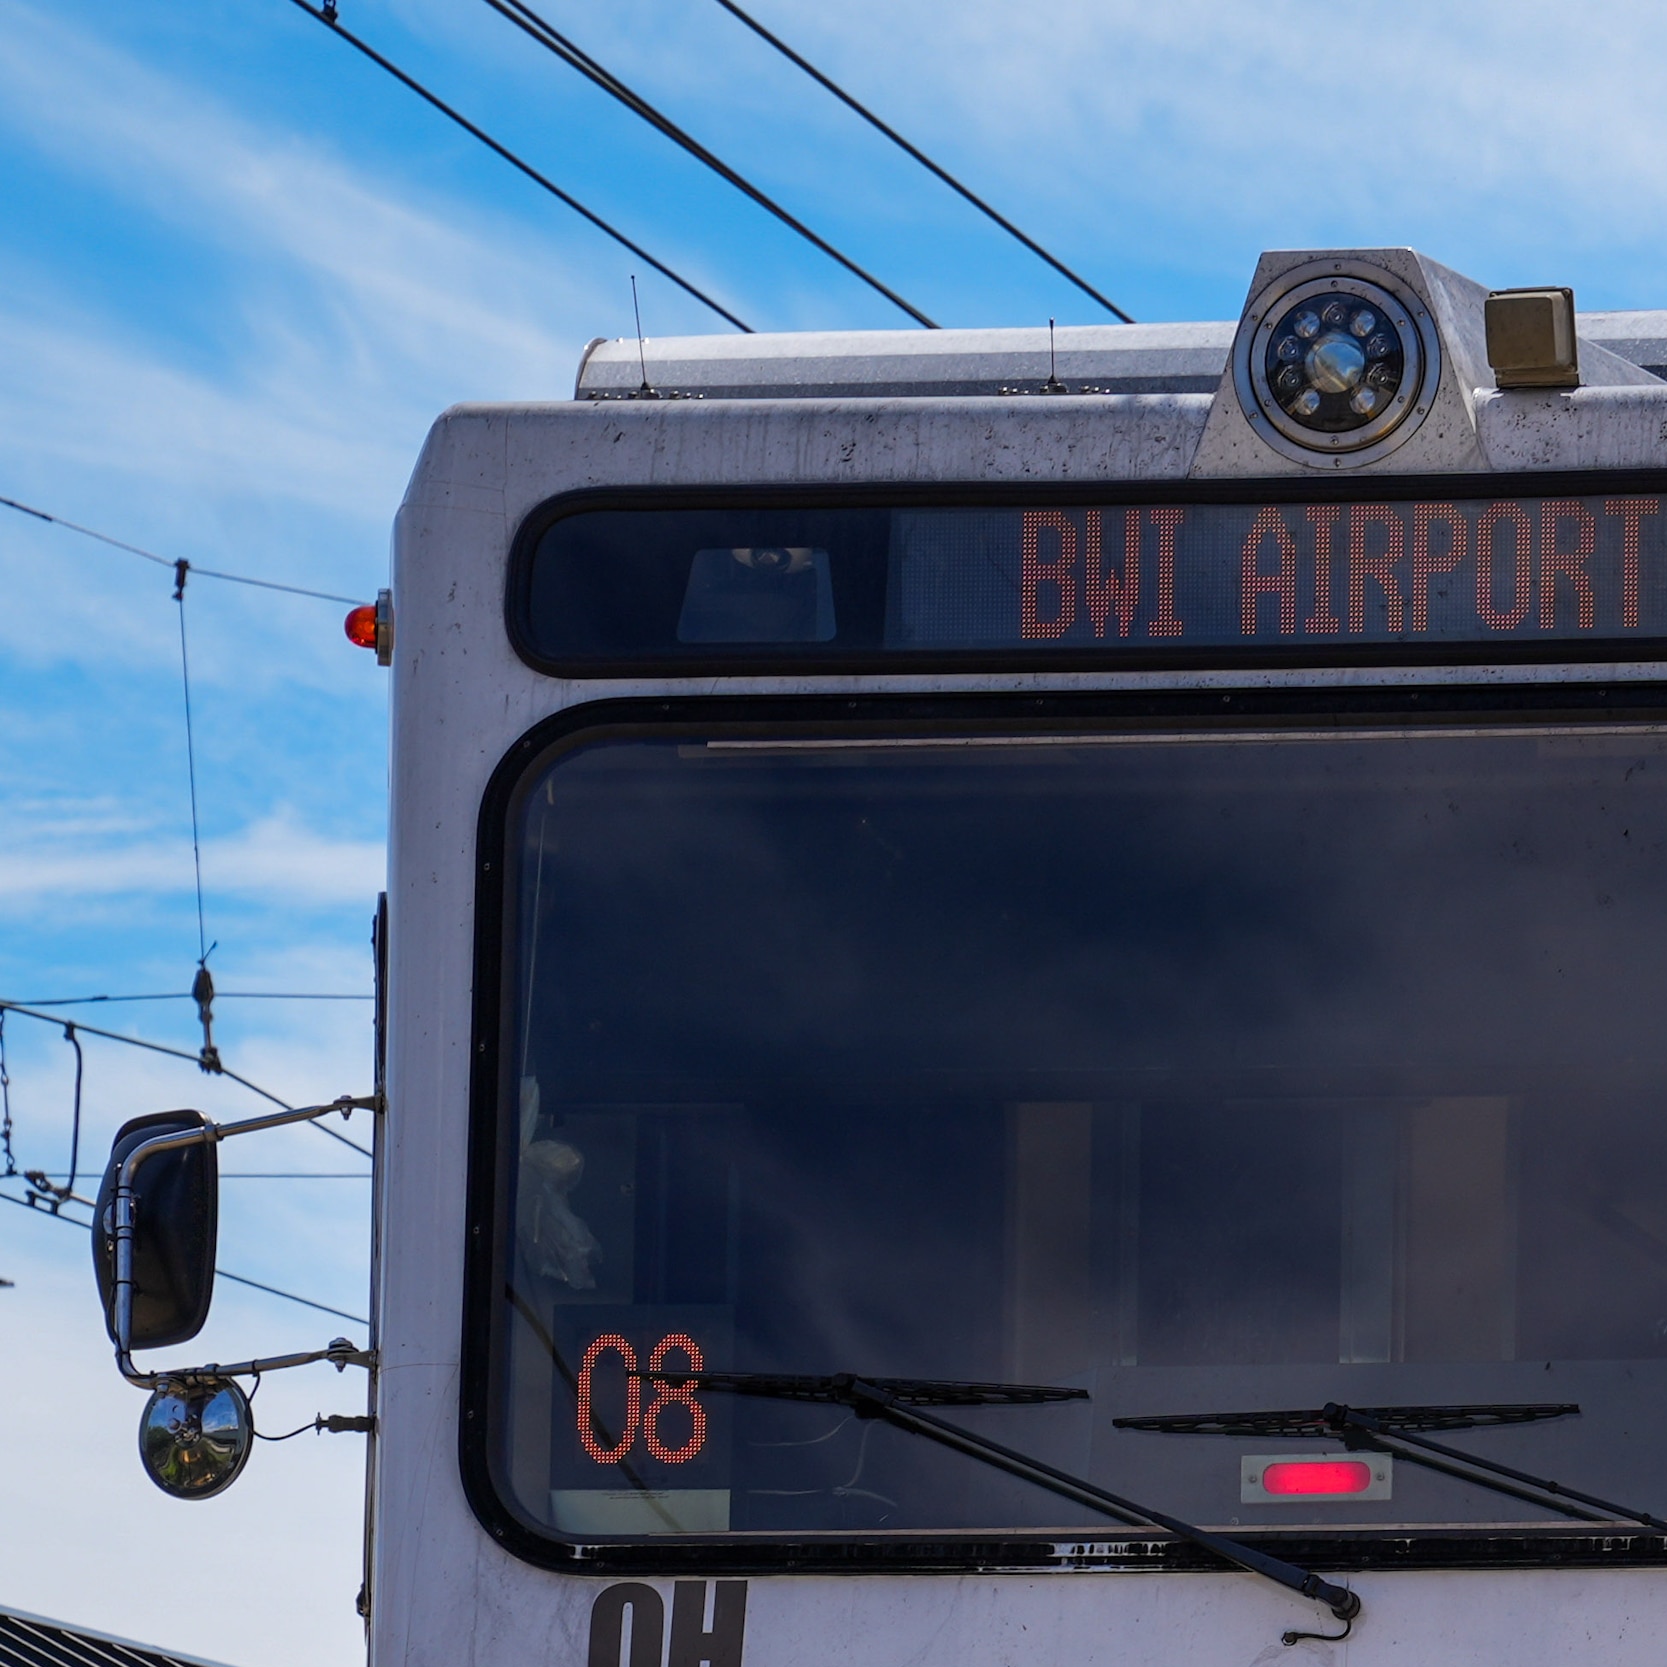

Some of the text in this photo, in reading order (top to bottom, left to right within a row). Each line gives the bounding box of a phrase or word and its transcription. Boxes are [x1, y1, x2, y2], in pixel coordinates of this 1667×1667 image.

[1021, 499, 1661, 639] BWI AIRPORT
[577, 1333, 708, 1464] 08
